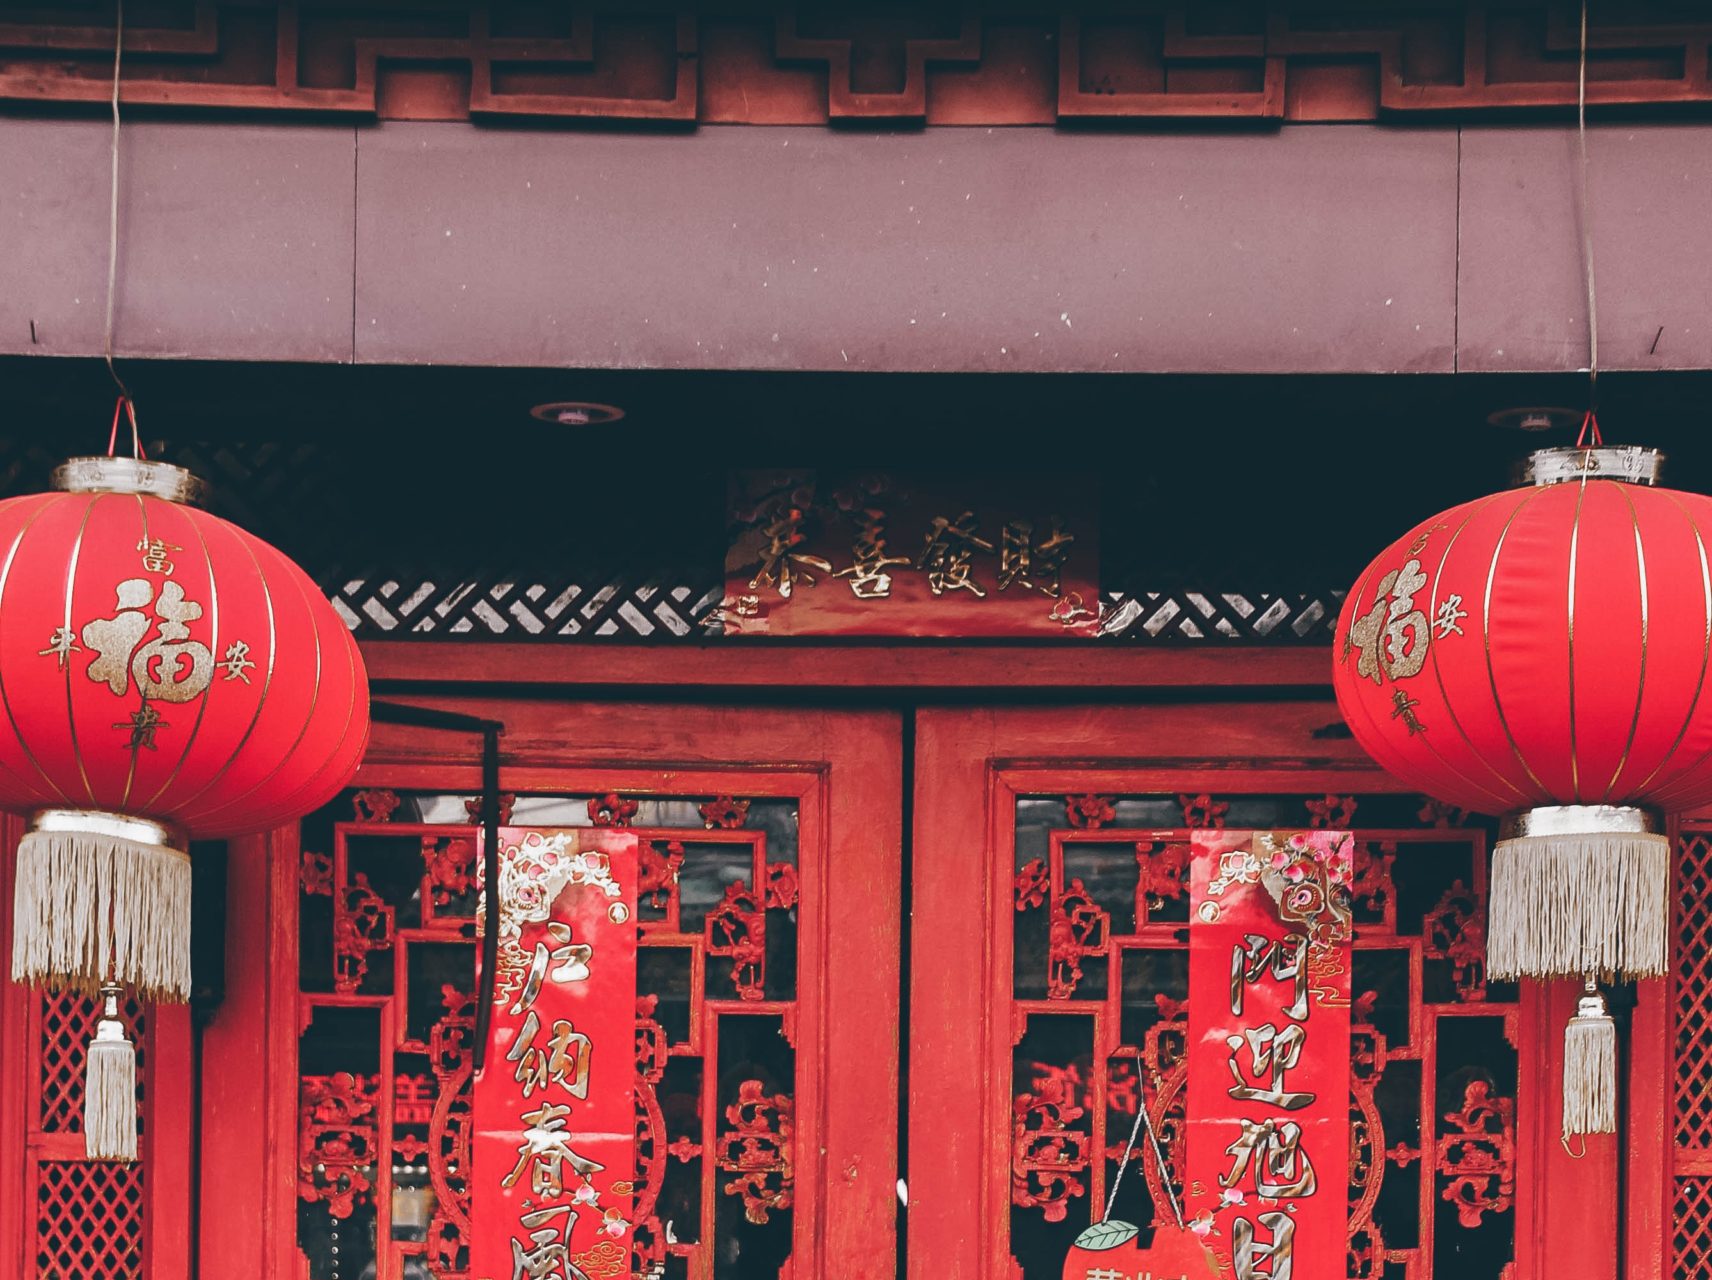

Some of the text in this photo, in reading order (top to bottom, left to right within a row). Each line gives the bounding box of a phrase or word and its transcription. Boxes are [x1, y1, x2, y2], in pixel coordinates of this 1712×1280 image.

[136, 538, 184, 576] 富
[1352, 559, 1429, 686] 福
[1436, 594, 1468, 640] 安
[81, 577, 214, 704] 福
[216, 640, 256, 685] 安
